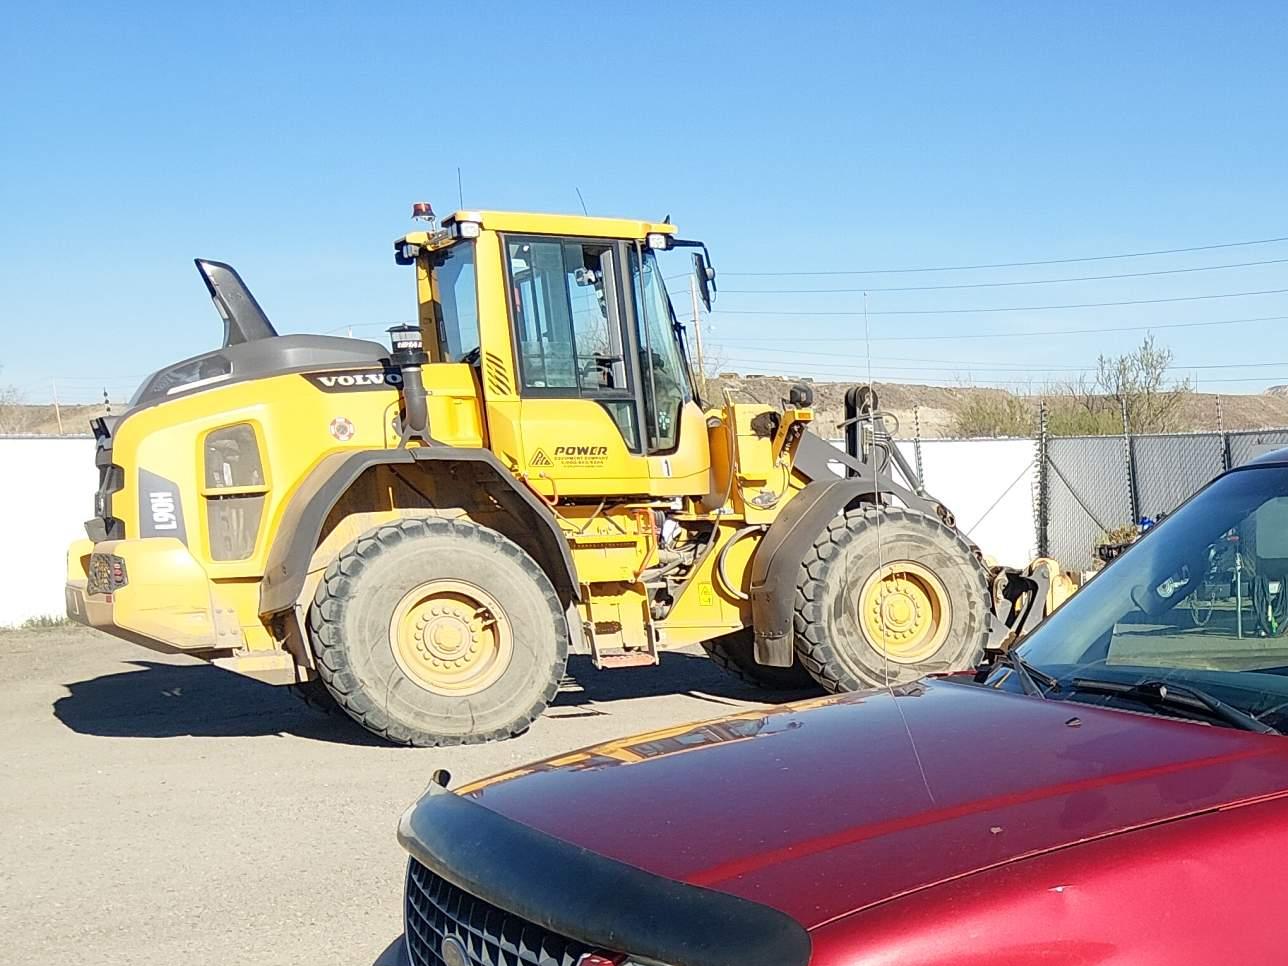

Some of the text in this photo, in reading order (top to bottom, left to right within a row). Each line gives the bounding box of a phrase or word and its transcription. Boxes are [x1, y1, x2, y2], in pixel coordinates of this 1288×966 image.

[317, 373, 403, 387] VOLVO
[554, 446, 608, 456] POWER
[149, 491, 178, 530] L90H
